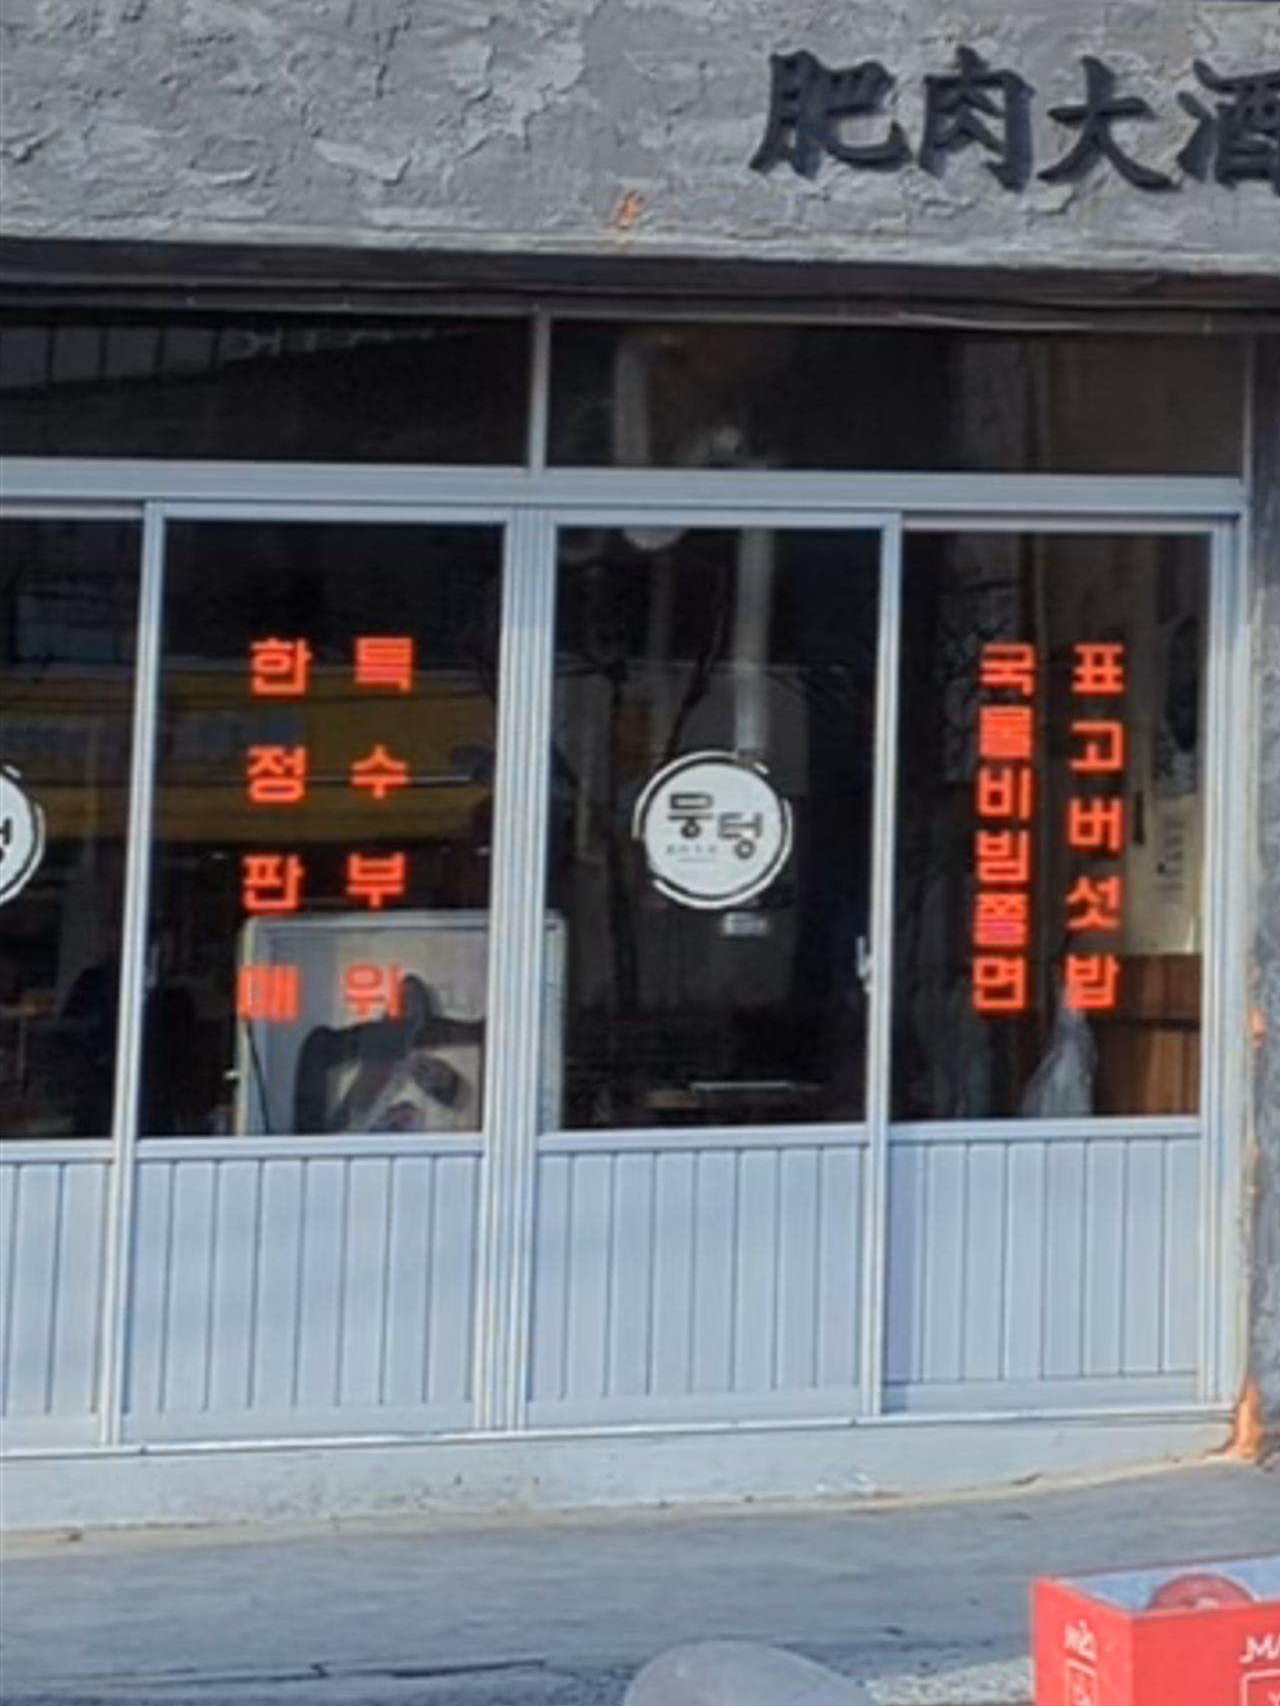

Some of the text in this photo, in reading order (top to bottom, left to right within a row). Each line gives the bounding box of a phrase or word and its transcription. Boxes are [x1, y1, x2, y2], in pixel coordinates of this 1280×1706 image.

[238, 637, 314, 1024] 한정판매
[342, 636, 415, 1020] 특수부위
[1064, 644, 1125, 1010] 표고버섯밥
